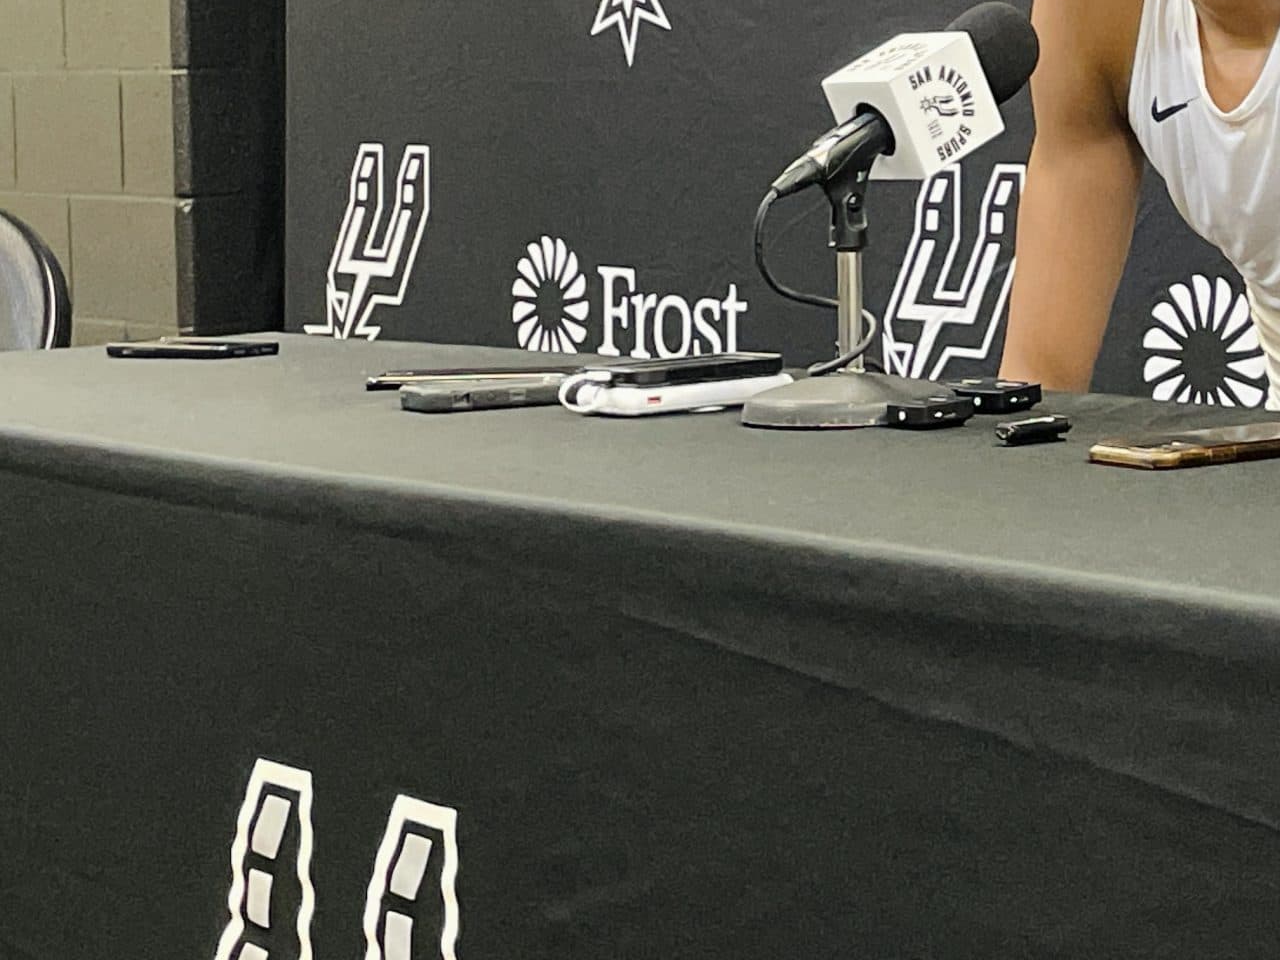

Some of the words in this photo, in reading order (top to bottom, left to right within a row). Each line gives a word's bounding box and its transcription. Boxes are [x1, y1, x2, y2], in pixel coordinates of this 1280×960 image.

[908, 64, 933, 91] SAN
[938, 64, 975, 117] ANTONIO
[936, 123, 972, 161] SPURS
[597, 265, 749, 360] Frost
